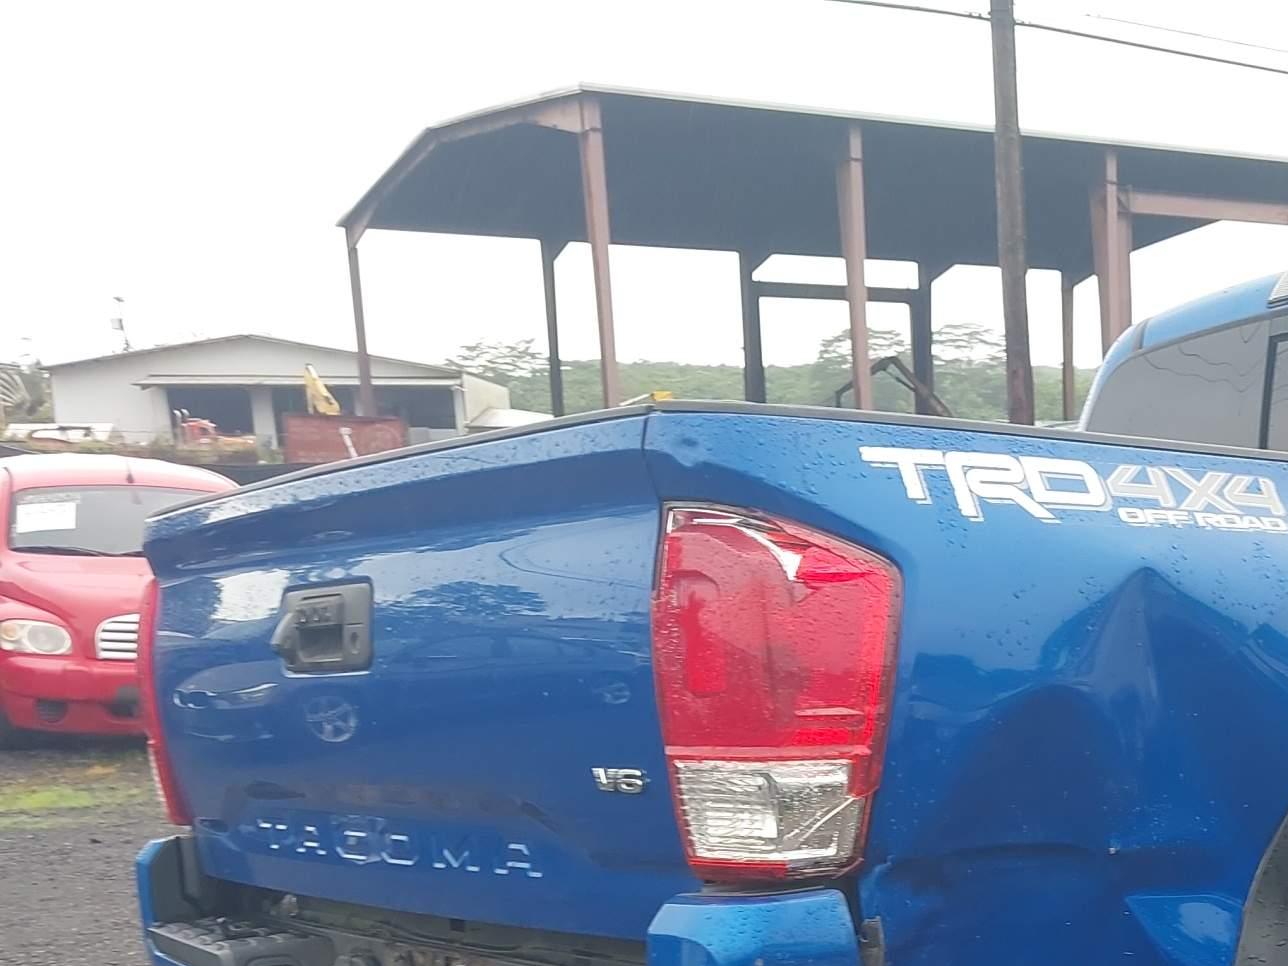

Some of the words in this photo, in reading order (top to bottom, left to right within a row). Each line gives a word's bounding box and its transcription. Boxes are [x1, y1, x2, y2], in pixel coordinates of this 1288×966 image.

[859, 446, 1112, 523] TRD
[1117, 507, 1193, 529] OFF
[591, 767, 644, 794] V6
[256, 817, 544, 879] TACOMA
